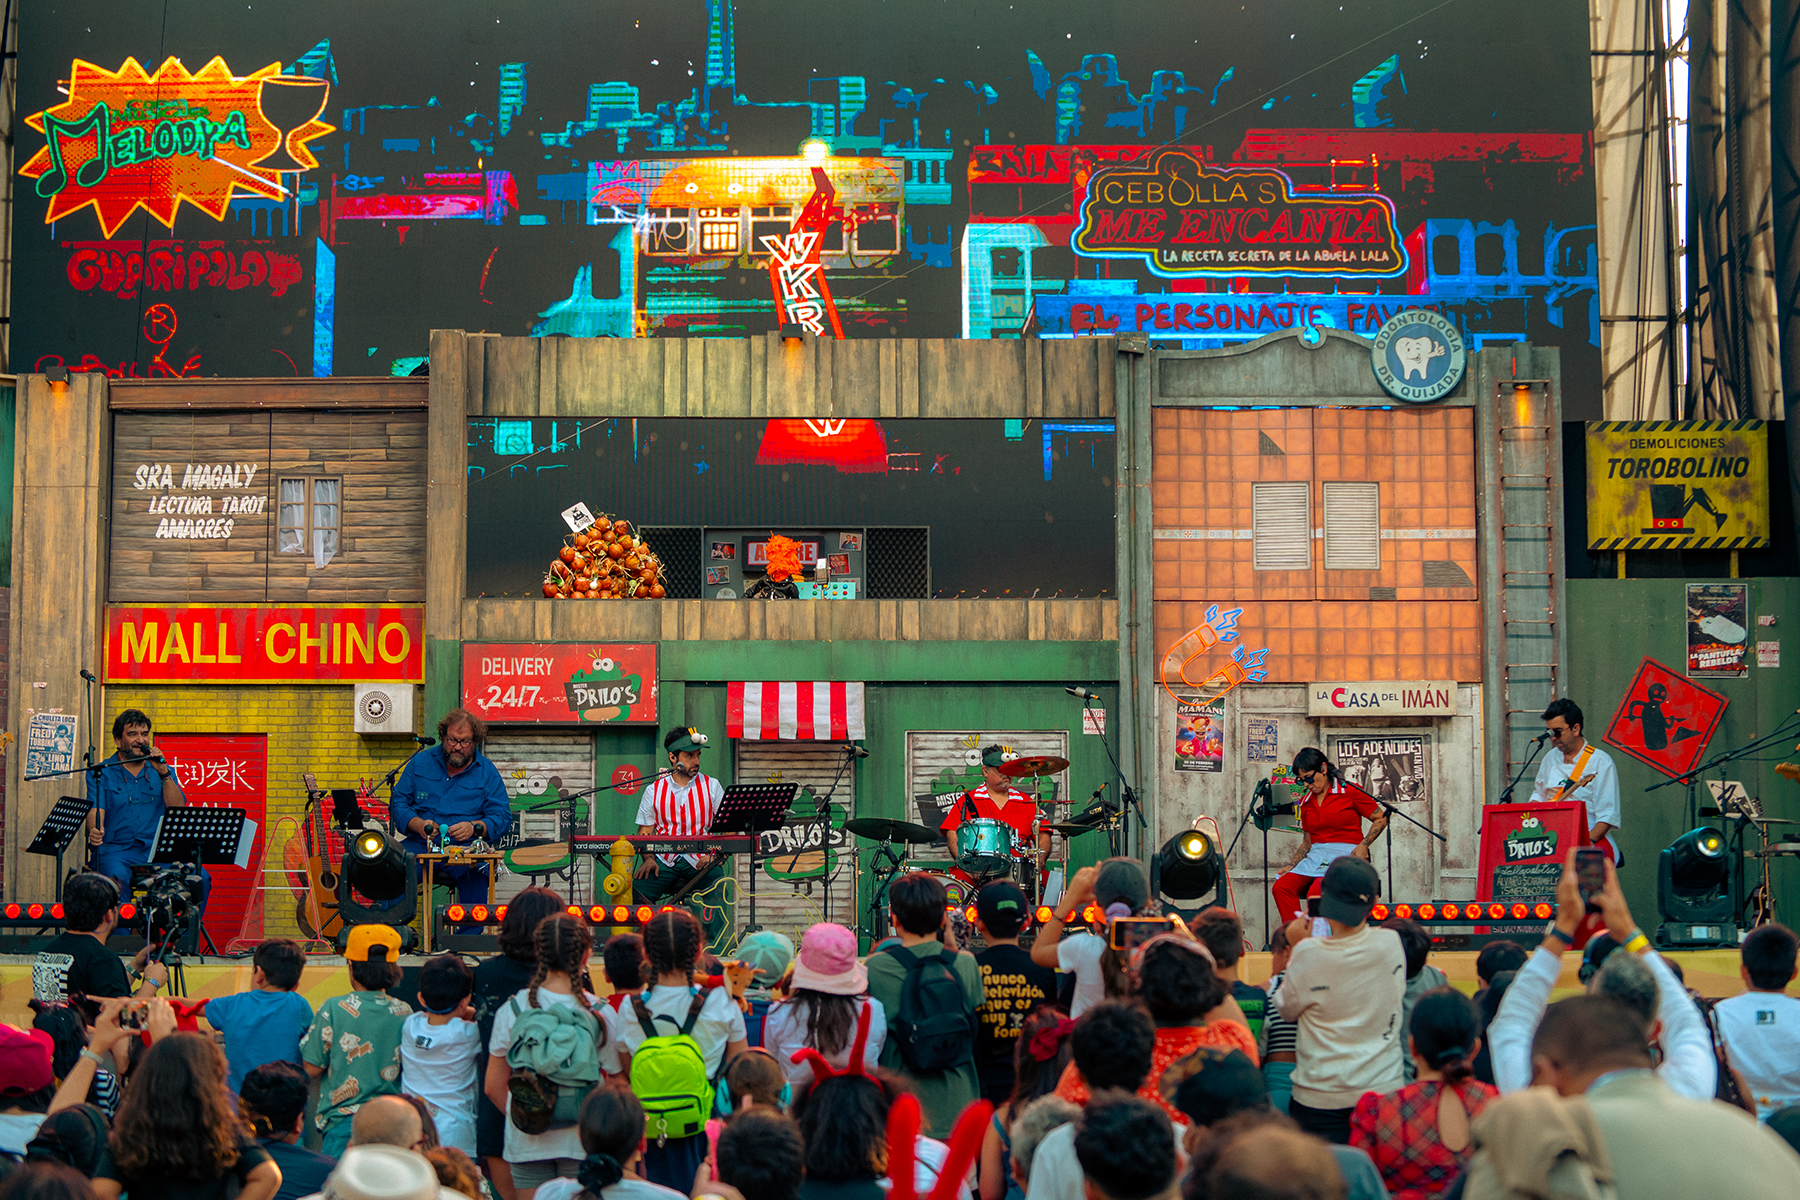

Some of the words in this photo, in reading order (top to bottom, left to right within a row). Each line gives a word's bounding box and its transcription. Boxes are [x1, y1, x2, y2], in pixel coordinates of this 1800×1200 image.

[1090, 208, 1167, 244] ME
[1172, 208, 1386, 244] ENCANTA
[1163, 250, 1178, 262] LA
[1181, 250, 1224, 262] RECETA
[1227, 250, 1275, 262] SECRETA
[1279, 250, 1292, 262] DE
[1295, 250, 1310, 262] LA
[1314, 250, 1357, 262] ABUELA
[1361, 250, 1389, 262] LALA
[1070, 303, 1120, 330] EL
[1136, 303, 1324, 330] PERSONAJE
[1376, 313, 1462, 353] ODONTOLOGIA
[1378, 366, 1395, 389] DR.
[1401, 367, 1459, 398] QUIJADA
[1629, 438, 1725, 450] DEMOLICIONES
[181, 463, 258, 490] MAGALY
[1607, 456, 1749, 478] TOROBOLINO
[148, 495, 213, 515] LECTURA
[221, 495, 268, 515] TAROT
[155, 518, 234, 538] AMARRES
[121, 622, 241, 664] MALL
[265, 622, 411, 664] CHINO
[1698, 649, 1743, 661] PANTUFLA
[1700, 656, 1738, 668] REBELDE
[482, 657, 554, 675] DELIVERY
[487, 685, 541, 707] 24/7
[574, 685, 637, 707] DRILO'S
[1317, 691, 1328, 700] LA
[1331, 687, 1380, 708] CASA
[1381, 693, 1398, 701] DEL
[1402, 684, 1449, 708] IMÁN
[1178, 705, 1223, 715] MAMANI
[31, 728, 56, 738] FREDY
[48, 753, 65, 763] LINO
[66, 754, 71, 763] Y
[1338, 742, 1360, 758] LOS
[1362, 739, 1422, 756] ADENOIDES
[618, 770, 635, 790] 31
[1273, 767, 1287, 775] 29
[1508, 841, 1554, 859] DRILO'S
[983, 974, 1026, 985] nunca
[1015, 999, 1032, 1009] es
